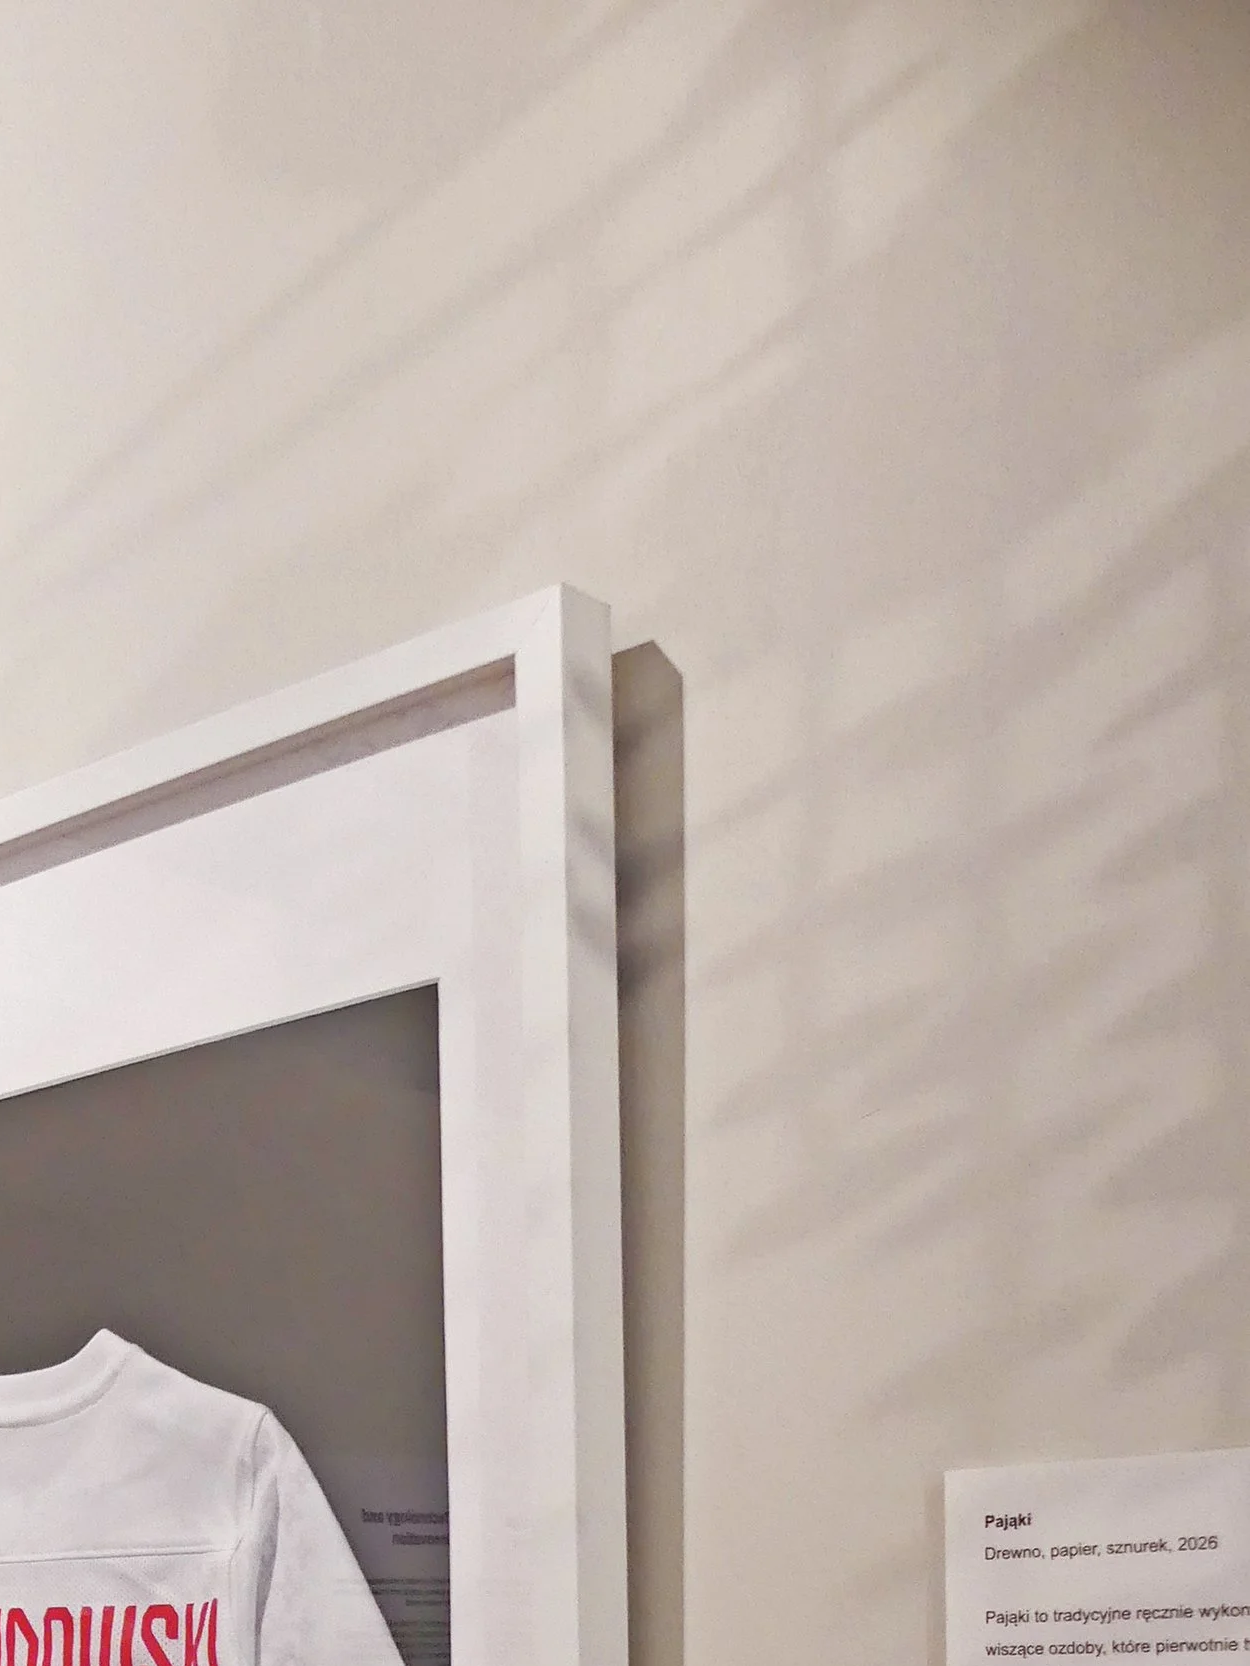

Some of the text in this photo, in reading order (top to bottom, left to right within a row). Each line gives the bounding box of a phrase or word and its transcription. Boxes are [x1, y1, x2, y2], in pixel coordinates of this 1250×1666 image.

[985, 1513, 1031, 1530] Pająki
[985, 1536, 1218, 1560] Drewno, papier, sznurek, 2026
[986, 1610, 1030, 1626] Pająki
[1035, 1609, 1048, 1623] to
[1053, 1607, 1131, 1625] tradycyjne
[1136, 1605, 1193, 1623] ręcznie
[986, 1643, 1043, 1658] wiszące
[1049, 1640, 1106, 1657] ozdoby,
[1112, 1640, 1150, 1654] które
[1156, 1638, 1238, 1655] pierwotnie
